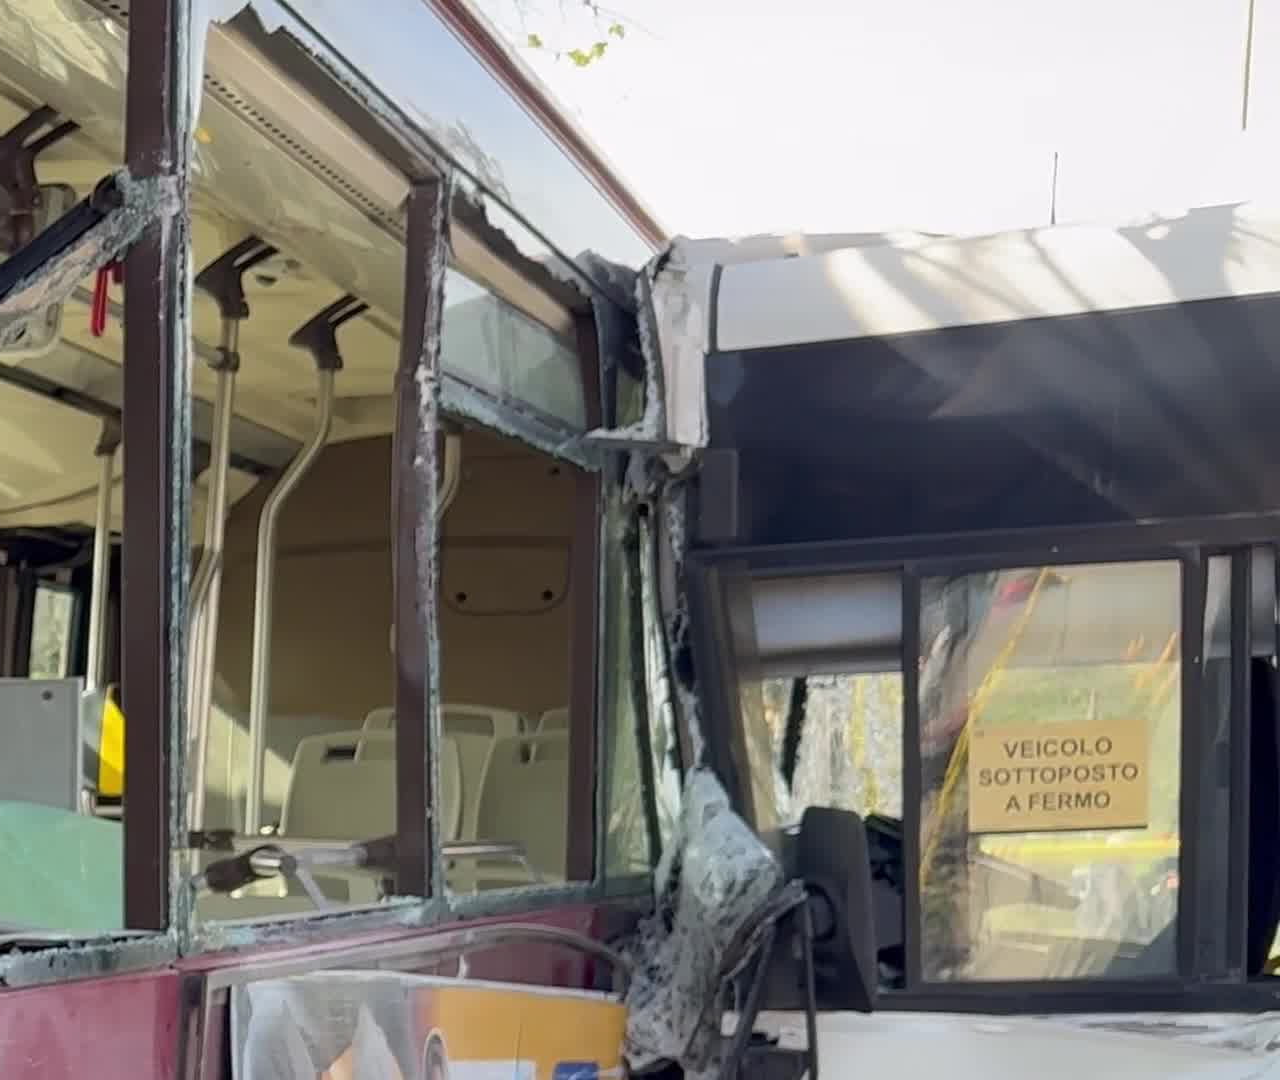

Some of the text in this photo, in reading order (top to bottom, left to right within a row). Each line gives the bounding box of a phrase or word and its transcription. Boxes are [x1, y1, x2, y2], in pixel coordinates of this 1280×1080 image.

[1003, 736, 1113, 760] VEICOLO
[979, 762, 1139, 787] SOTTOPOSTO
[1004, 791, 1111, 813] A FERMO
